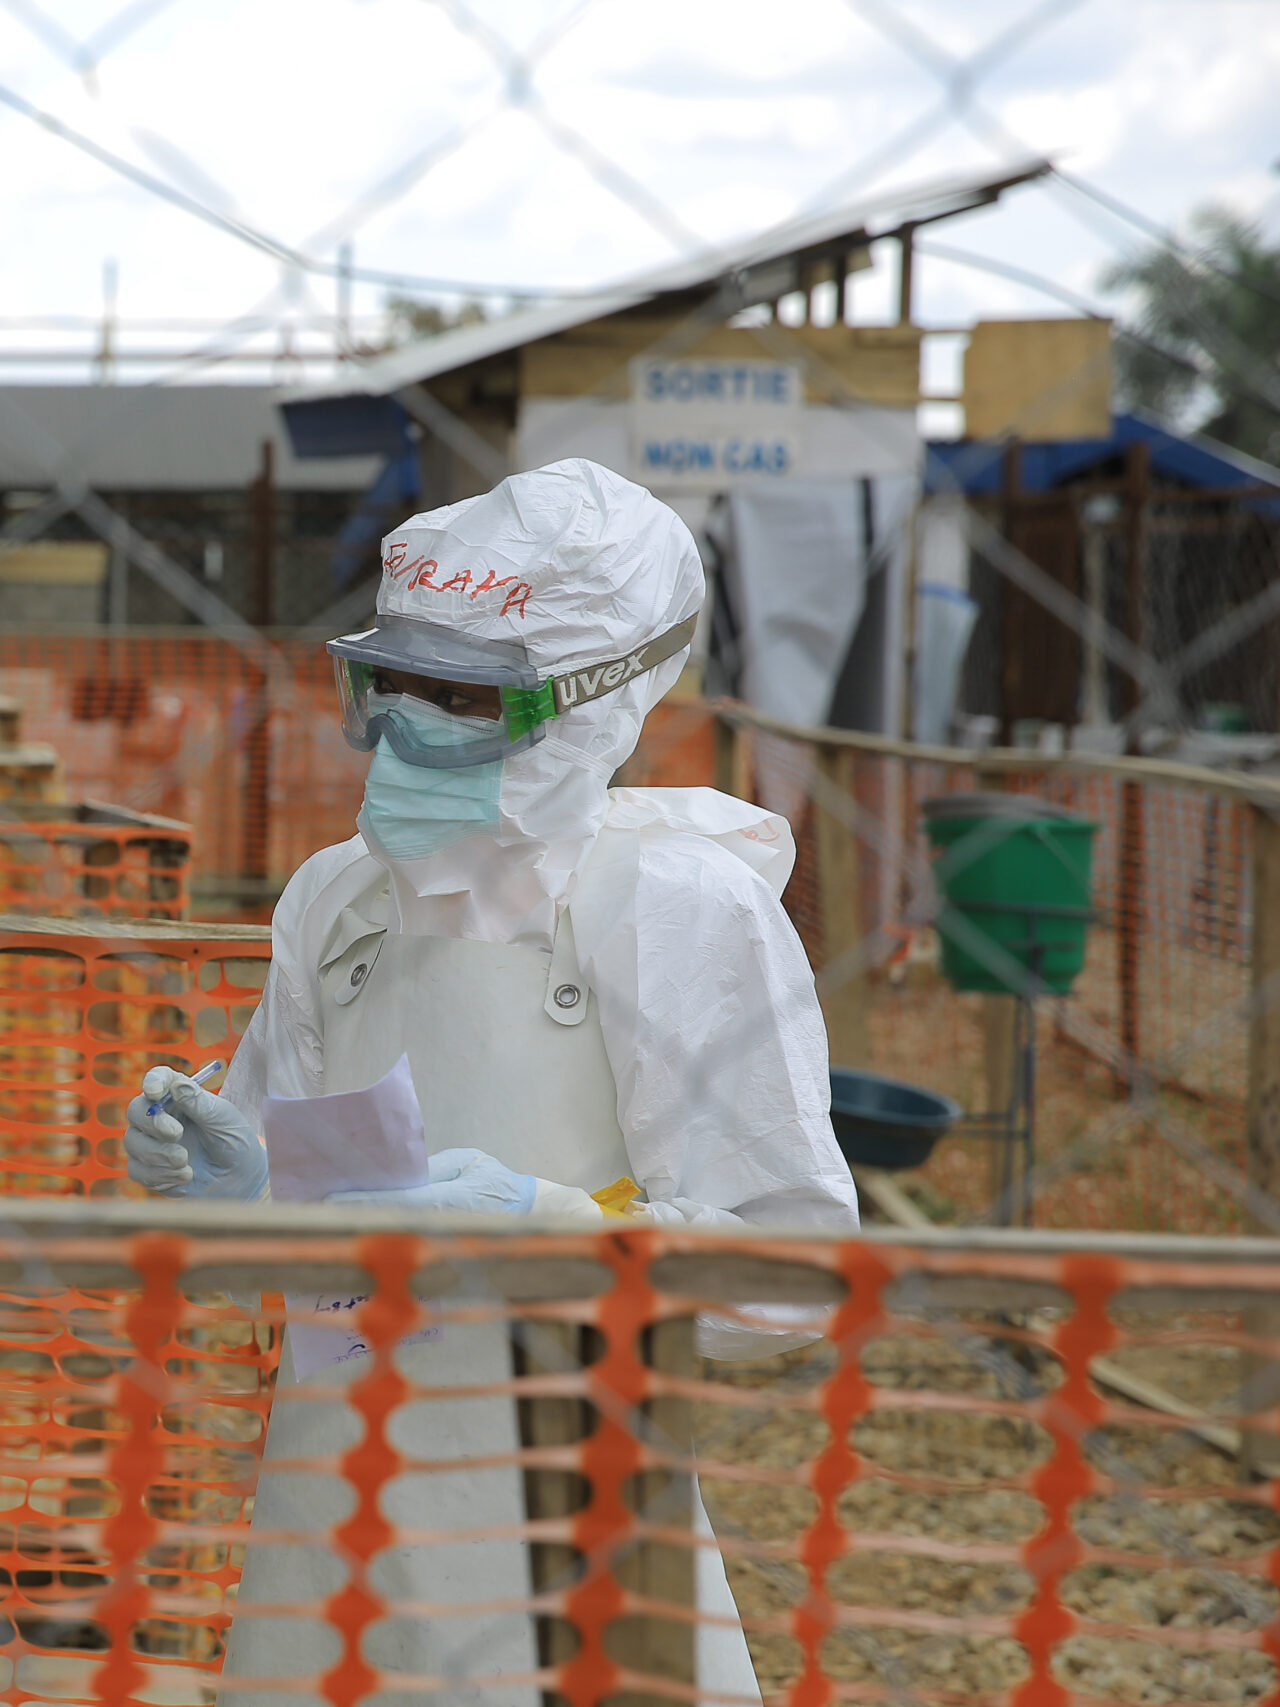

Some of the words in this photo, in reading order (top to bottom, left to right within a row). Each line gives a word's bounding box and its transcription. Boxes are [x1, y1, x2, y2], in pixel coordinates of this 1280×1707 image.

[646, 364, 789, 401] SORTIE
[644, 440, 715, 474] NON
[724, 440, 790, 476] CAS
[560, 647, 649, 706] uvex
